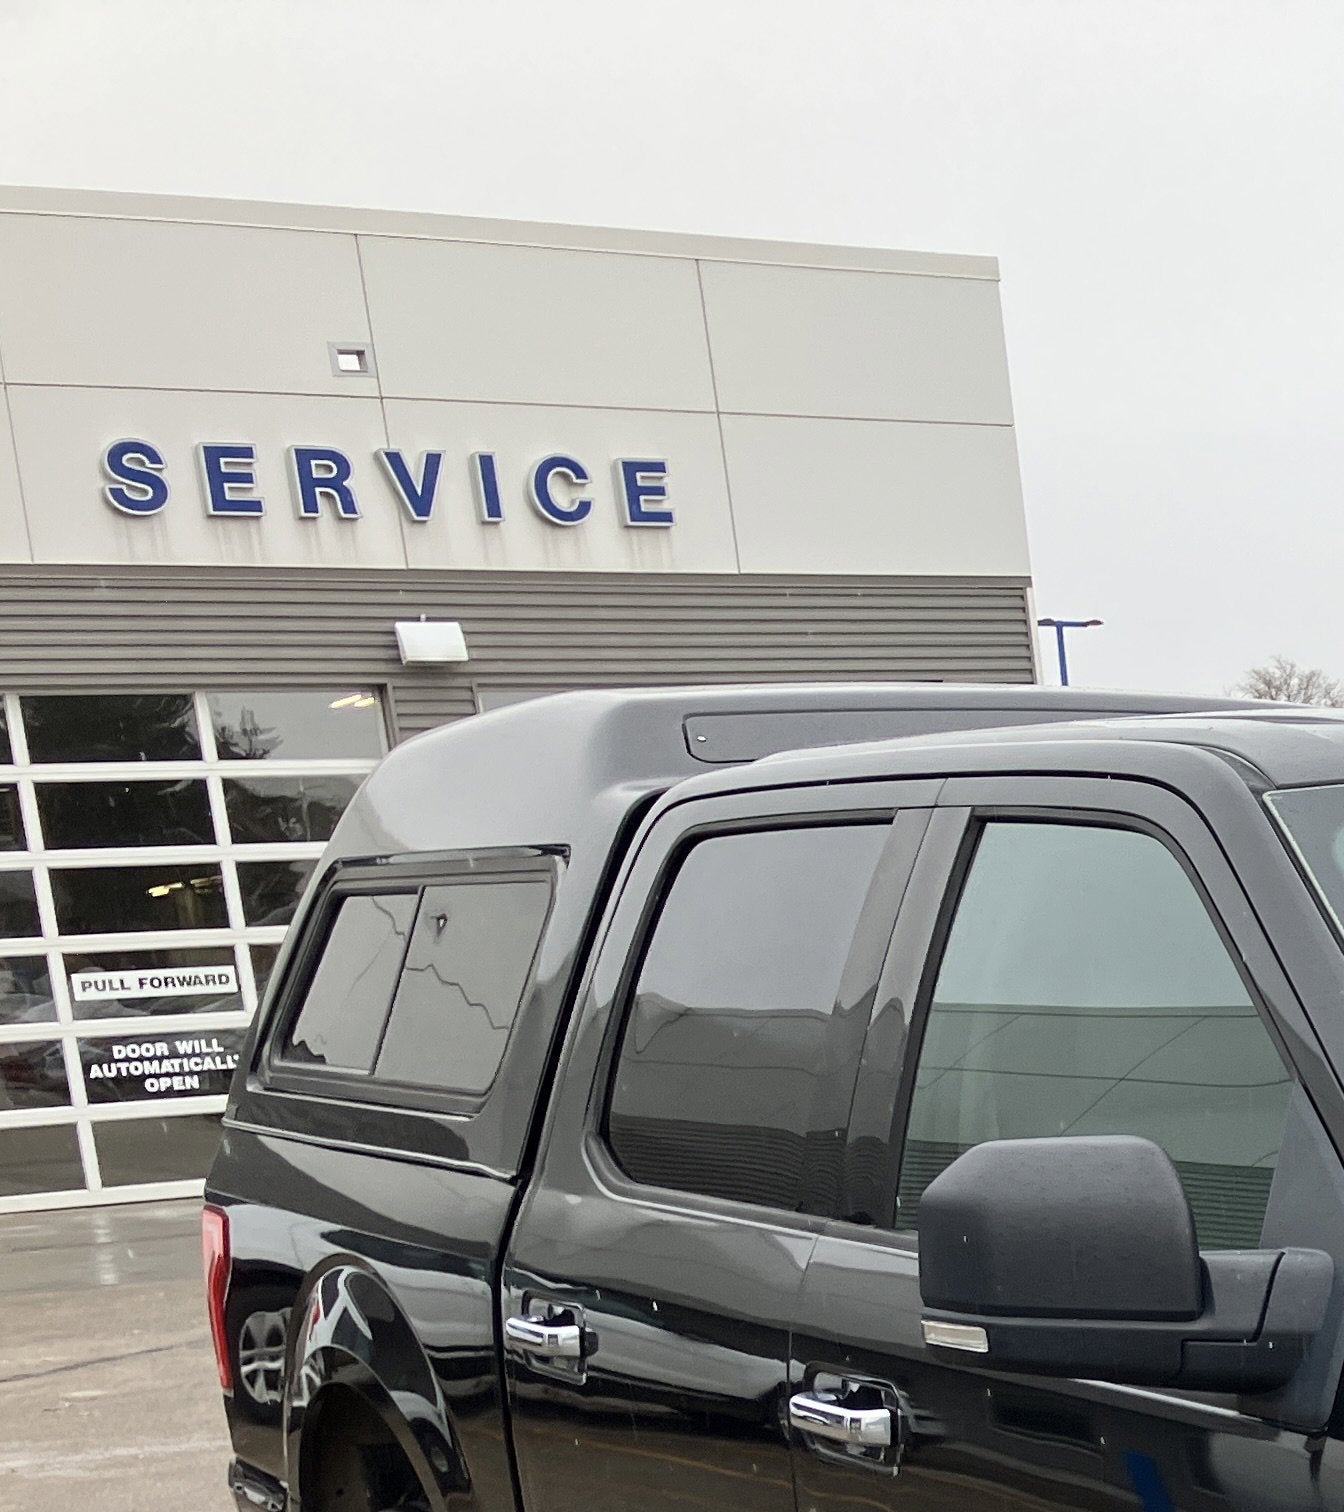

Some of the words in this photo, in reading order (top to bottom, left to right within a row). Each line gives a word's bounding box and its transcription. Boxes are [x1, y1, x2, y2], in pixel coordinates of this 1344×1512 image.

[101, 437, 676, 528] SERVICE
[81, 978, 131, 993] PULL
[138, 973, 230, 990] FORWARD
[112, 1041, 169, 1060] DOOR
[175, 1038, 225, 1055] WILL
[89, 1054, 240, 1080] AUTOMATICALL
[144, 1075, 200, 1093] OPEN
